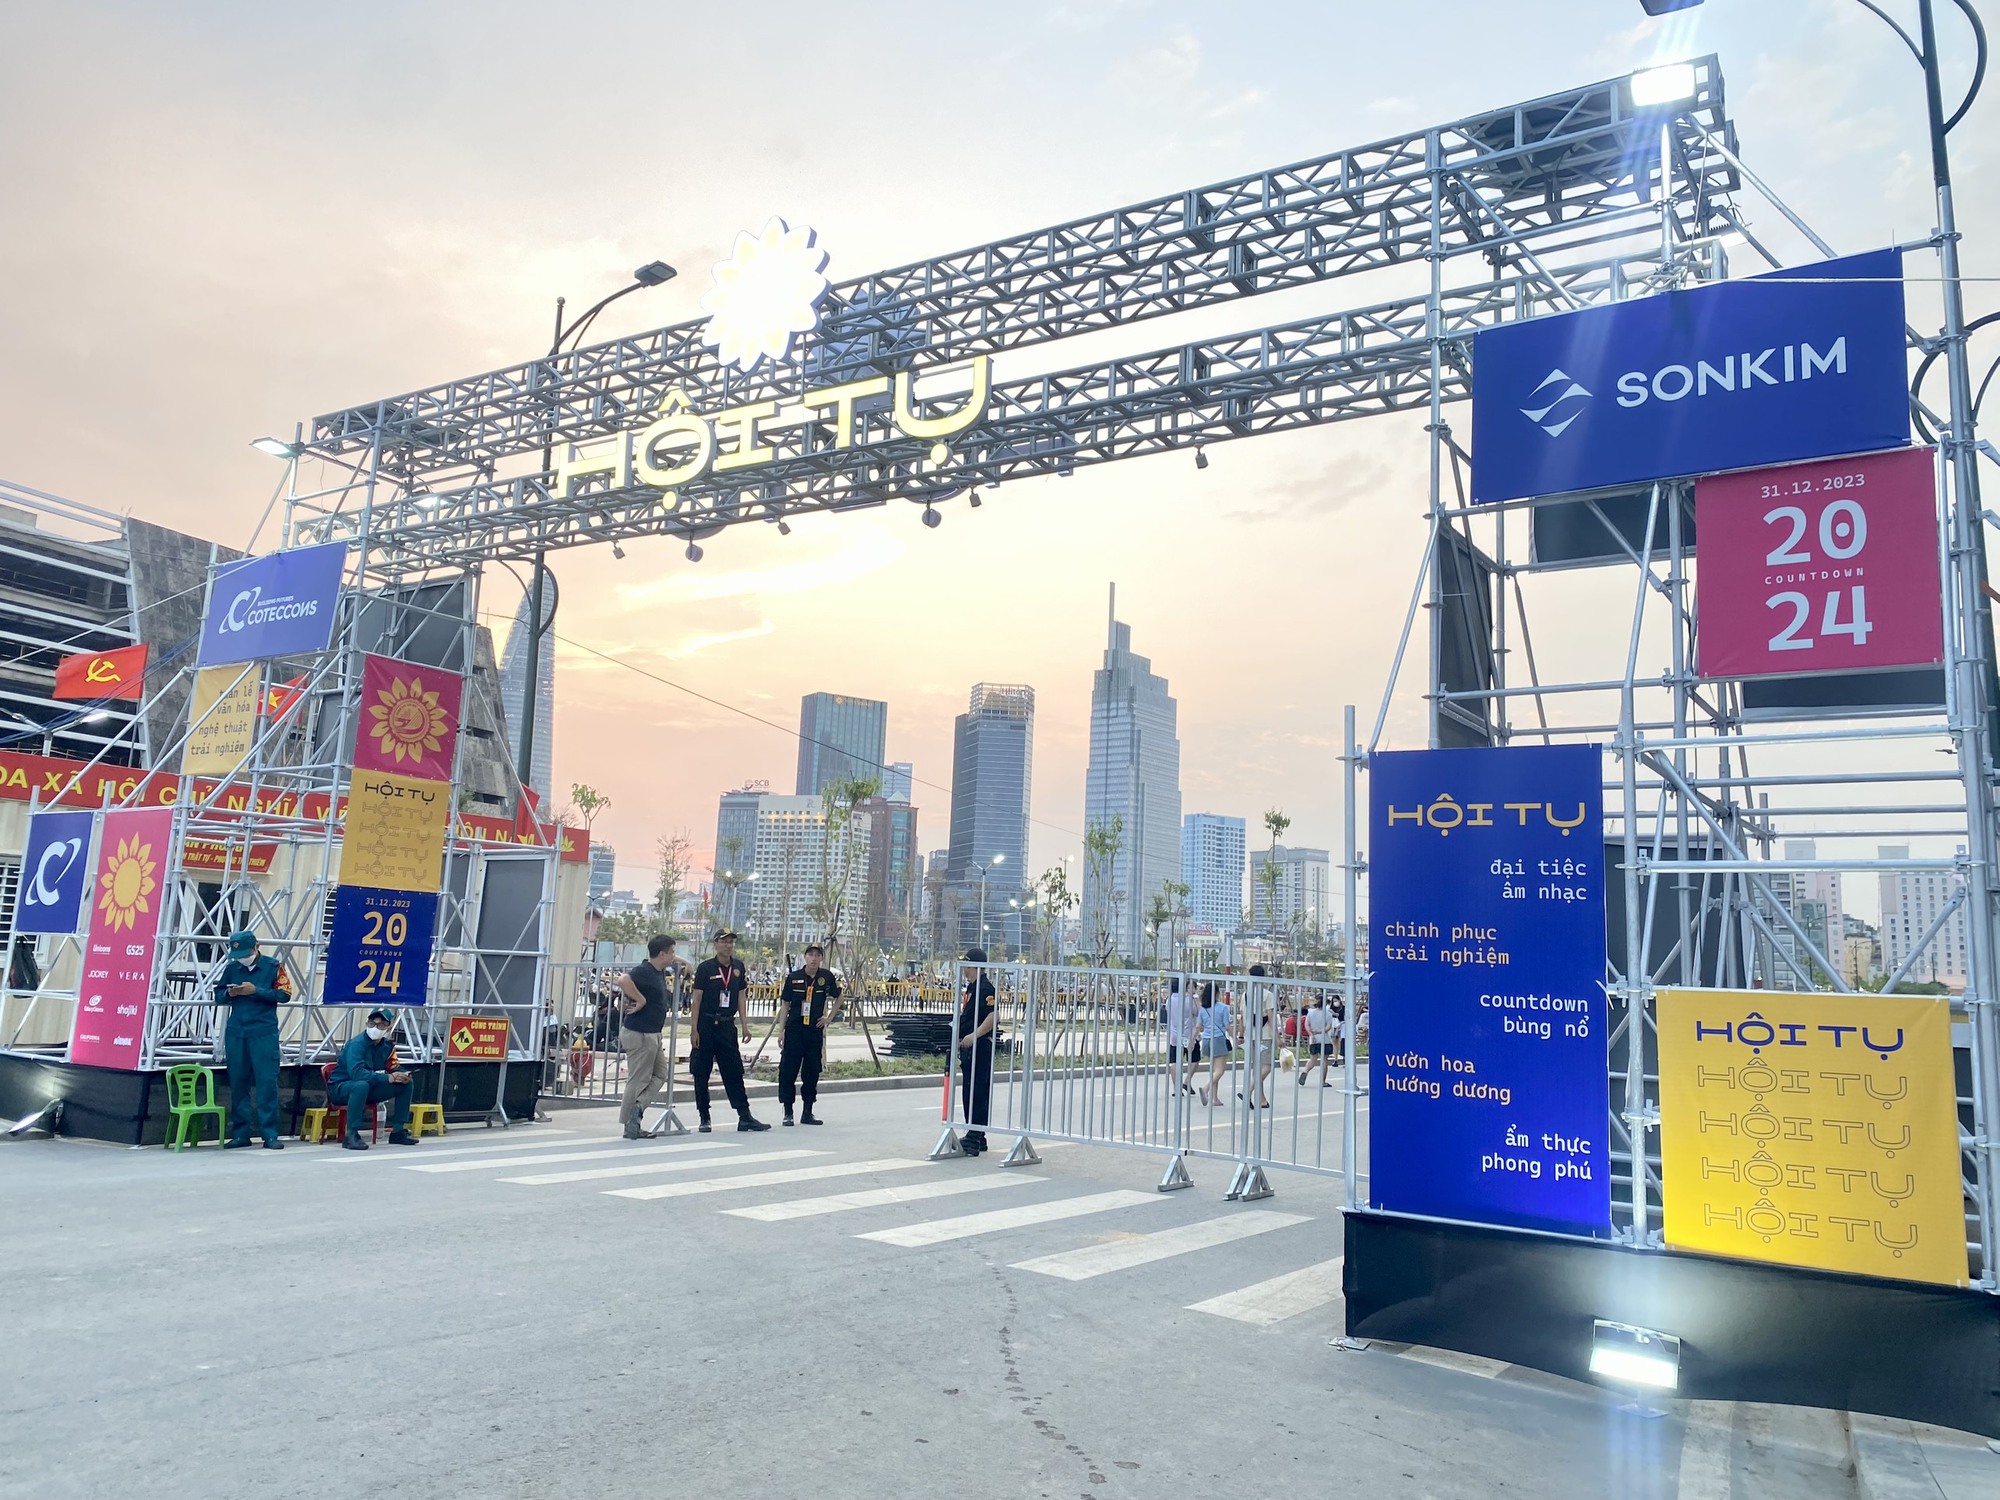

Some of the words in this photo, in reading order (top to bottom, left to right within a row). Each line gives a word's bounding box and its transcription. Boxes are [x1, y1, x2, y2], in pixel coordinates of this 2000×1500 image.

[1615, 336, 1848, 408] SONKIM
[557, 386, 780, 512] HỘI
[804, 354, 994, 467] TỤ
[1761, 473, 1866, 499] 31.12.2023
[1762, 499, 1867, 567] 20
[1764, 567, 1865, 585] COUNTDOWN
[1764, 585, 1873, 652] 24
[365, 780, 404, 799] HỘI
[408, 788, 435, 805] TỤ
[754, 779, 770, 787] SCB
[1388, 793, 1494, 837] HỘI
[1503, 802, 1586, 837] TỤ
[1490, 858, 1525, 878] đại
[1538, 858, 1587, 880] tiệc
[365, 898, 410, 908] 31.12.2023
[1502, 881, 1525, 899] âm
[1538, 883, 1587, 903] nhạc
[361, 911, 407, 946] 20
[1384, 922, 1439, 938] chinh
[1451, 923, 1497, 943] phục
[126, 945, 144, 956] GS25
[1384, 944, 1428, 961] trải
[1440, 947, 1510, 967] nghiệm
[88, 970, 109, 978] JOCKEY
[119, 971, 145, 980] VERA
[355, 960, 401, 994] 24
[1480, 994, 1588, 1013] countdown
[1503, 1016, 1551, 1040] bùng
[1565, 1015, 1589, 1038] nổ
[1695, 1012, 1807, 1054] HỘI
[1818, 1025, 1904, 1060] TỤ
[1385, 1051, 1429, 1070] vườn
[1441, 1055, 1476, 1074] hoa
[1385, 1074, 1441, 1099] hướng
[1452, 1081, 1511, 1105] dương
[1697, 1057, 1810, 1102] HỘI
[1820, 1072, 1907, 1110] TỤ
[1505, 1124, 1529, 1148] ẩm
[1541, 1133, 1591, 1156] thực
[1699, 1103, 1813, 1148] HỘI
[1823, 1119, 1911, 1159] TỤ
[1482, 1152, 1541, 1178] phong
[1555, 1160, 1592, 1181] phú
[1702, 1151, 1816, 1196] HỘI
[1825, 1168, 1914, 1208] TỤ
[1704, 1198, 1818, 1244] HỘI
[1829, 1216, 1918, 1258] TỤ
